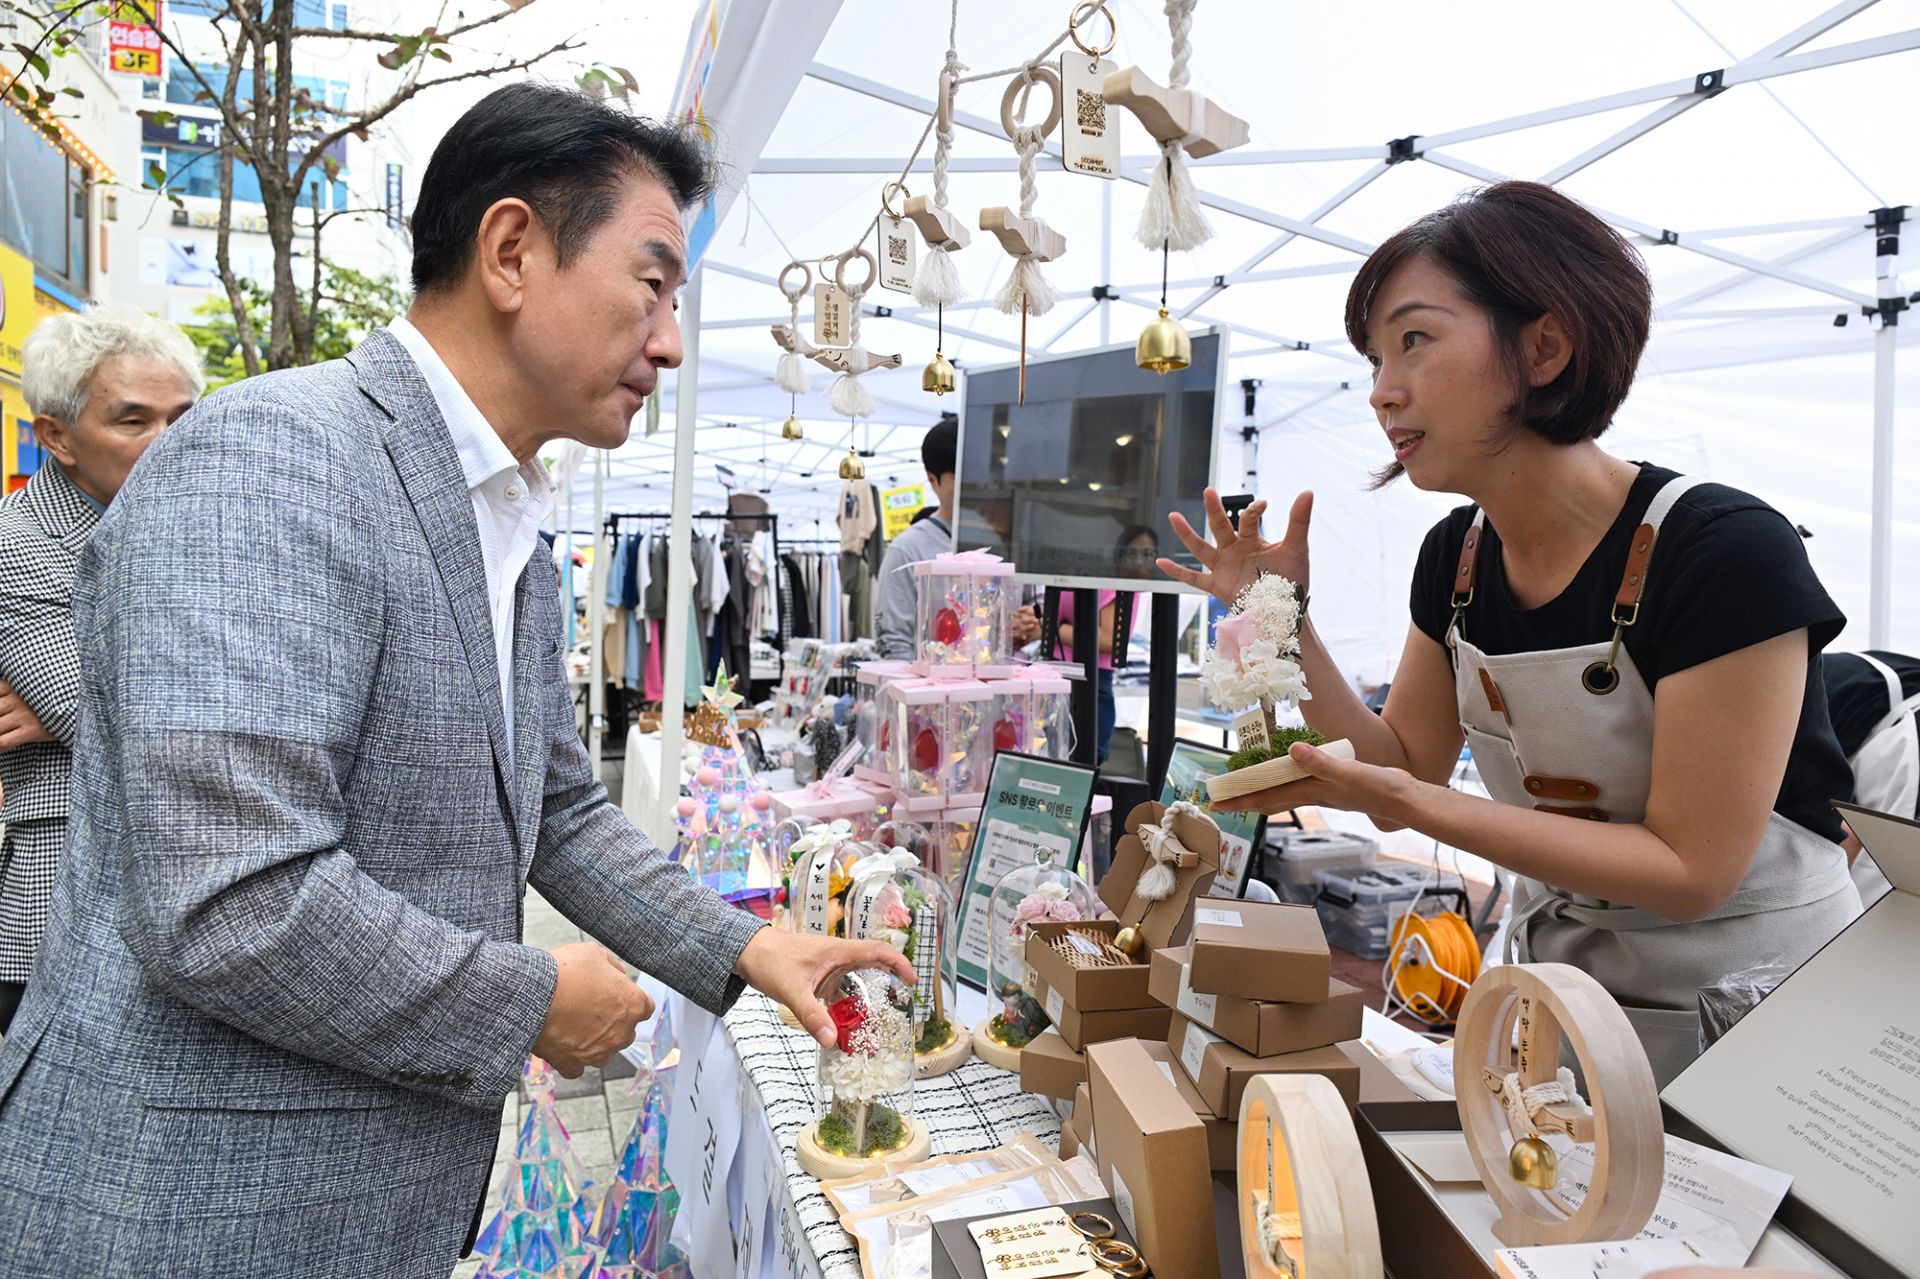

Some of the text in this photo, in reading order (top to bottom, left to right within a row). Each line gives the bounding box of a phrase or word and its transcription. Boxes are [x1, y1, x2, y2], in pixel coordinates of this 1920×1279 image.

[111, 26, 160, 49] 연습장
[999, 791, 1018, 806] SNS
[1046, 801, 1073, 819] 이벤트
[1816, 1069, 1824, 1077] A
[1823, 1072, 1843, 1087] Place
[1843, 1083, 1869, 1101] Where
[1869, 1097, 1903, 1120] Warmth
[1838, 1065, 1847, 1073] A
[1845, 1069, 1867, 1084] Piece
[1866, 1082, 1880, 1090] of
[1877, 1086, 1911, 1108] Warmth
[1775, 1084, 1919, 1175] the quiet warmth of natural wood and
[1809, 1089, 1847, 1112] Godambit
[1845, 1110, 1875, 1131] infuses
[1873, 1128, 1896, 1142] your
[1787, 1123, 1895, 1199] that makes you want to stay.
[1804, 1120, 1898, 1179] gifting you the comfort
[1652, 1214, 1678, 1230] 무드등
